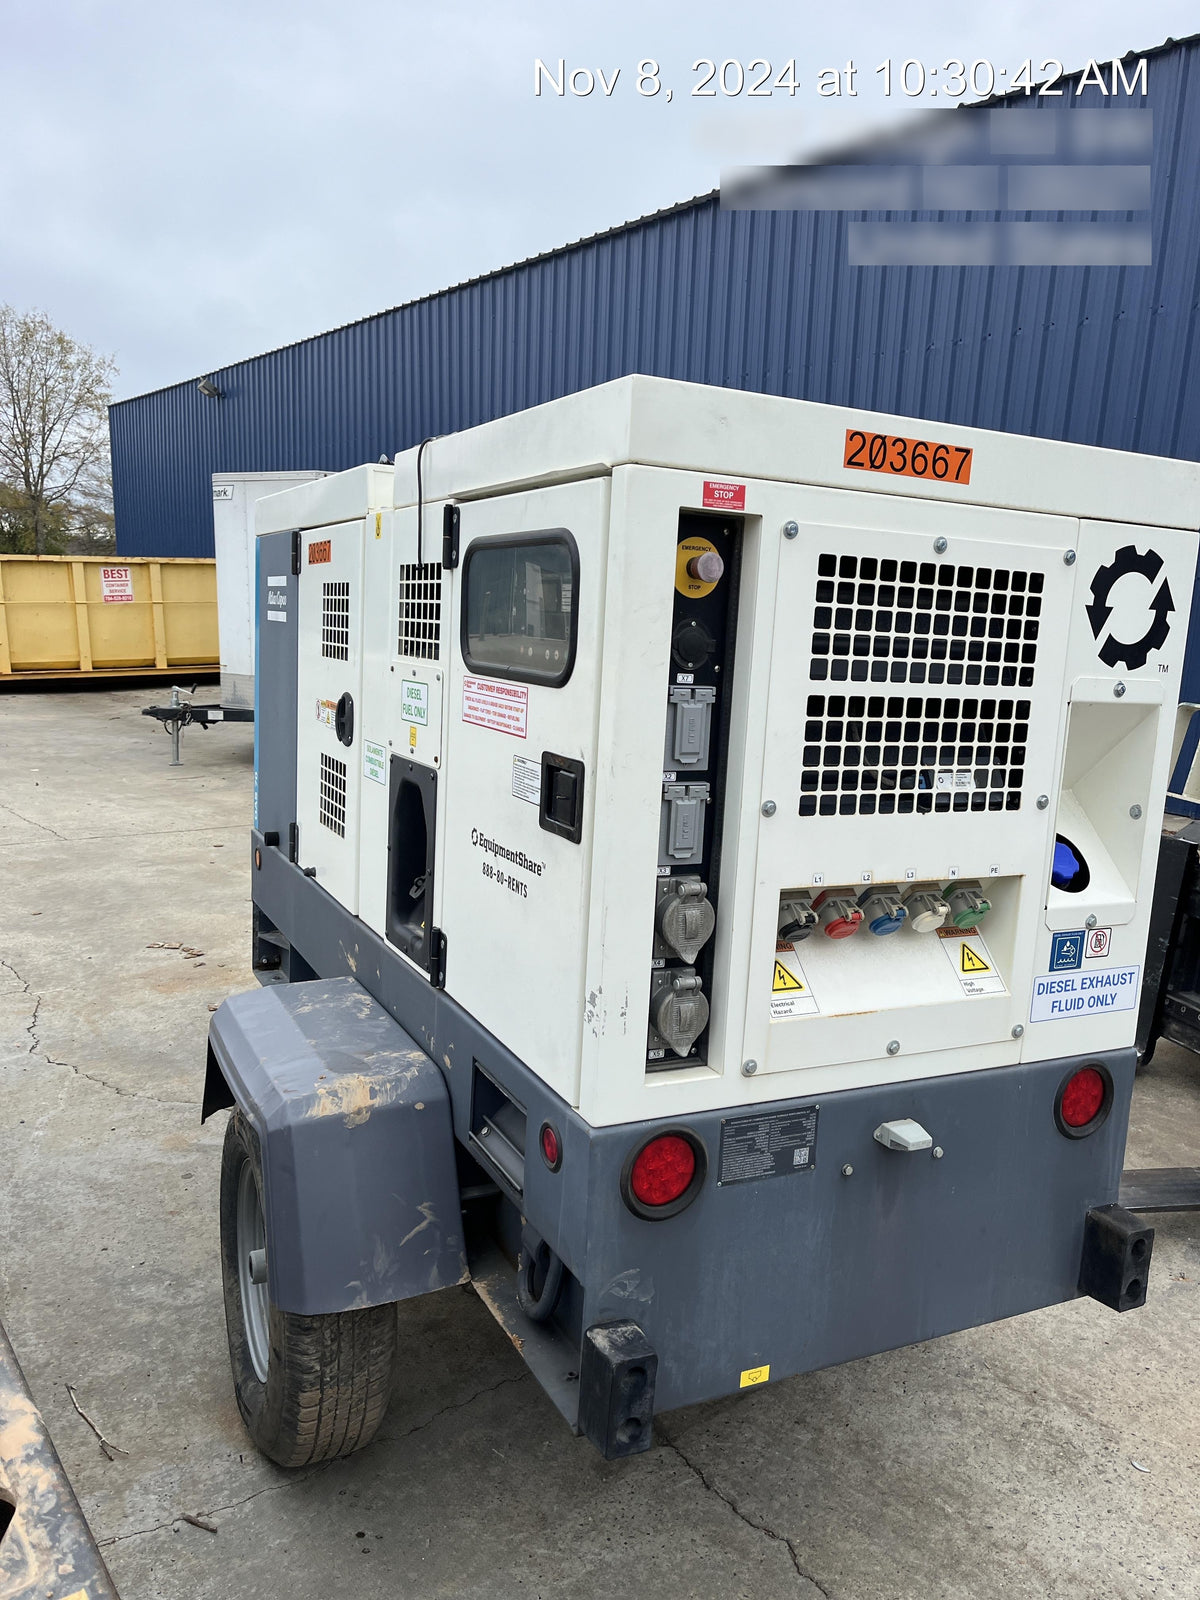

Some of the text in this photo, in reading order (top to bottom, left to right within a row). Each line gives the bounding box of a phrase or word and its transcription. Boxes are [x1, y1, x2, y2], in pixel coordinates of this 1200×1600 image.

[709, 482, 740, 491] EMERGENCY
[714, 490, 734, 499] STOP
[681, 544, 712, 552] EMERGENCY
[103, 568, 129, 579] BEST
[407, 687, 422, 700] DIESEL
[402, 703, 426, 719] FUEL ONLY
[482, 861, 528, 898] 888-80-RENTS
[943, 926, 977, 936] WARNING
[1037, 972, 1135, 996] DIESEL EXHAUST
[770, 1000, 795, 1008] Electrical
[1051, 992, 1118, 1014] FLUID ONLY
